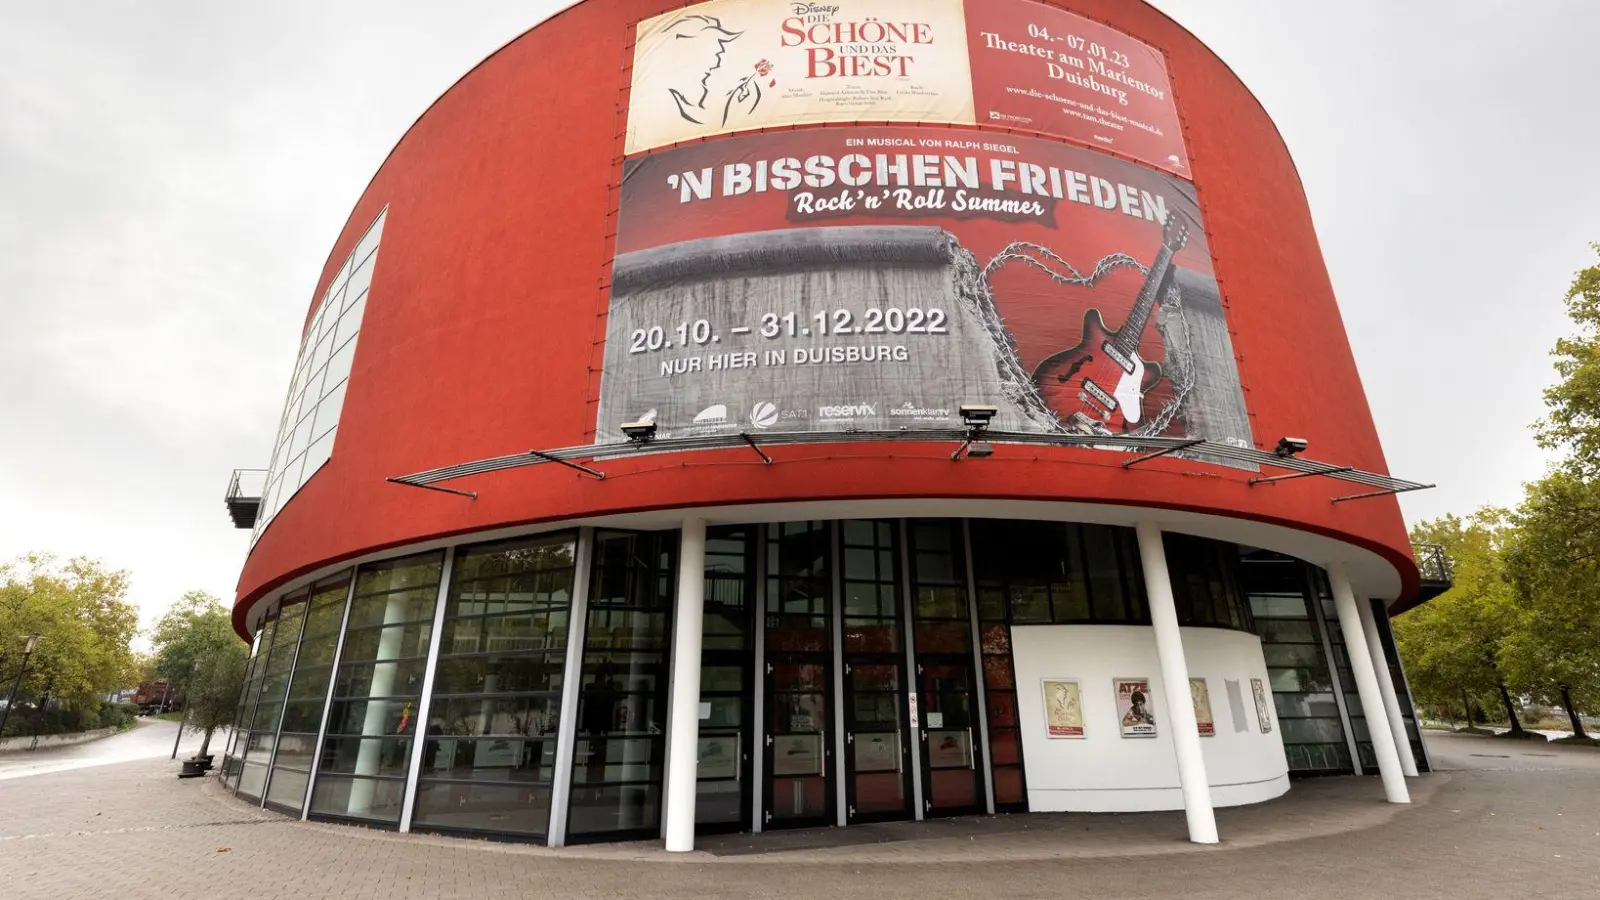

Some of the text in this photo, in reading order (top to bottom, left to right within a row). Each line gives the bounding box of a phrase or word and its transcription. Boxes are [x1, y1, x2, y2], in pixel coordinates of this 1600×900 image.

[790, 2, 839, 15] Disney
[808, 14, 830, 23] DIE
[781, 17, 934, 47] SCHÖNE
[804, 47, 914, 79] BIEST
[840, 45, 896, 54] UND DAS
[981, 31, 1165, 101] Theater am Marientor
[1047, 63, 1129, 105] Duisburg
[846, 138, 1020, 155] EIN MUSICAL VON RALPH SIEGEL
[723, 153, 980, 197] BISSCHEN
[990, 158, 1168, 226] FRIEDEN
[951, 189, 1045, 216] Summer
[629, 319, 719, 353] 20.10.
[760, 308, 947, 338] 31.12.2022
[660, 345, 909, 376] NUR HIER IN DUISBURG
[819, 402, 878, 420] reservix
[1119, 682, 1149, 693] ATZE
